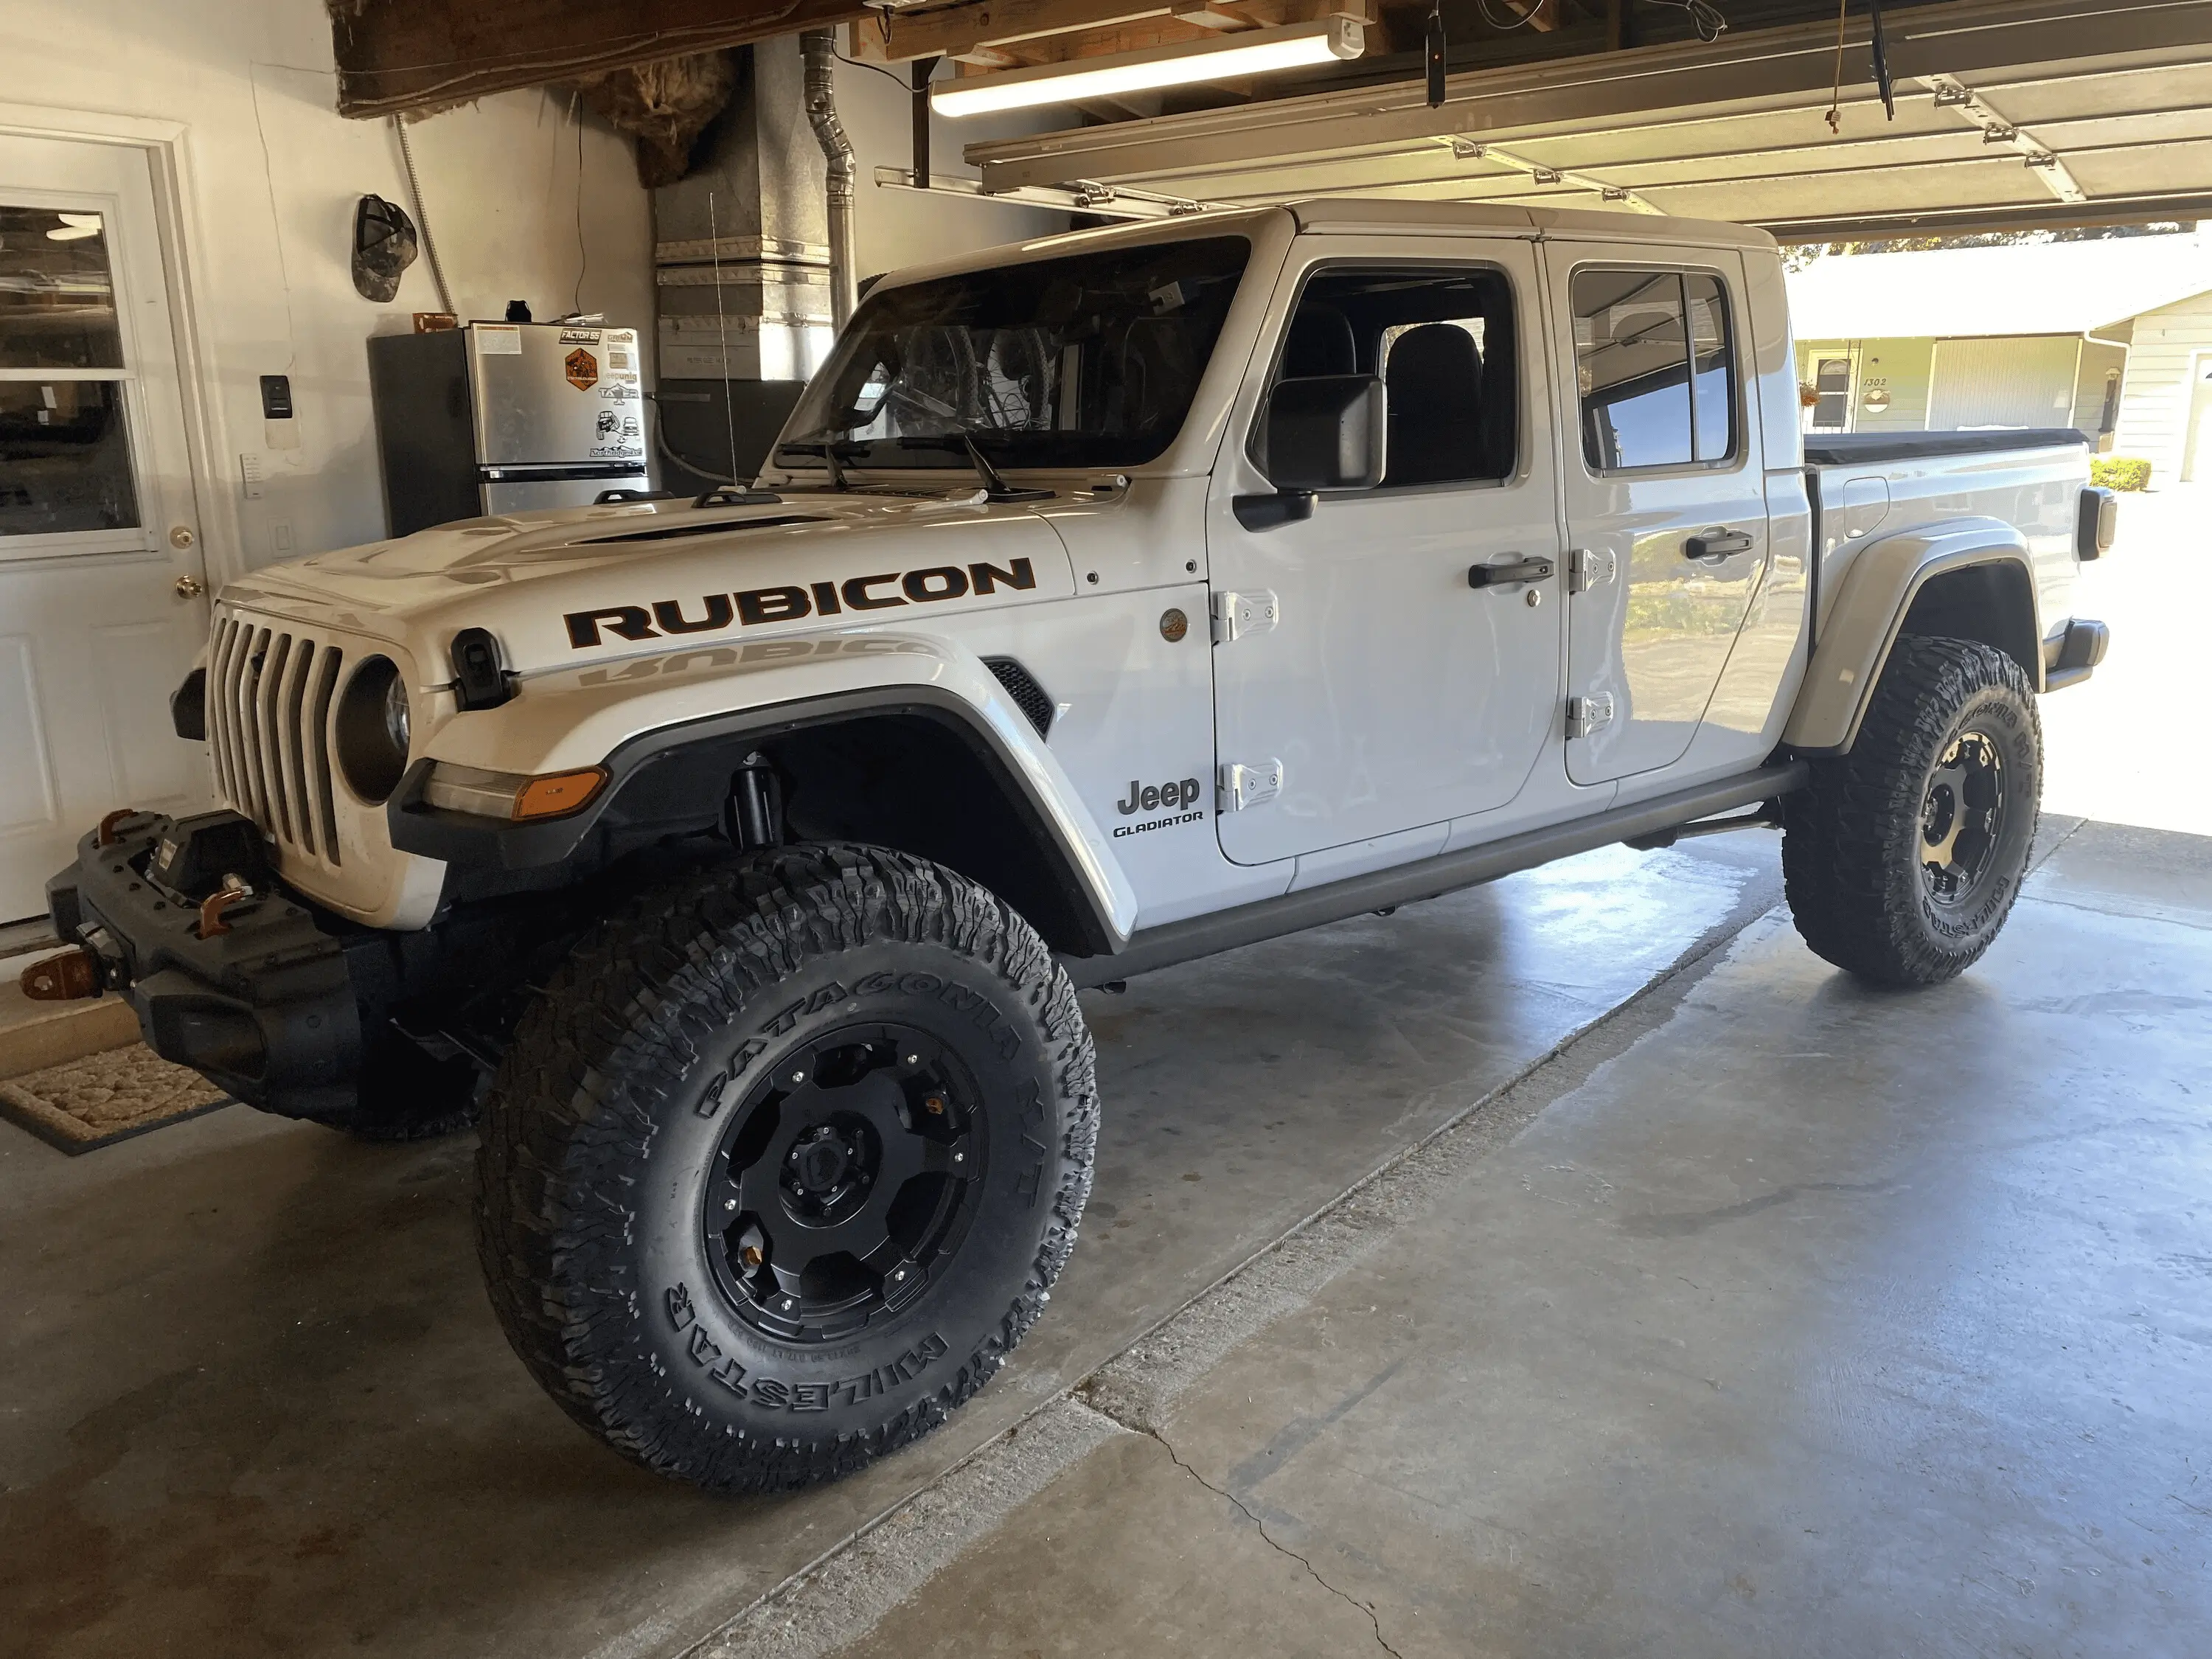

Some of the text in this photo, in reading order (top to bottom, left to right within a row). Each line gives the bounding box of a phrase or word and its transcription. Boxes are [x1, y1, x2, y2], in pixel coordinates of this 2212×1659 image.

[561, 330, 601, 340] FACTOR 55
[1864, 378, 1887, 386] 1302
[563, 557, 1037, 649] RUBICON
[1117, 778, 1200, 815] Jeep
[1113, 810, 1203, 838] GLADIATOR
[695, 971, 1022, 1119] PATAGONIA
[667, 1282, 950, 1411] MILESTAR
